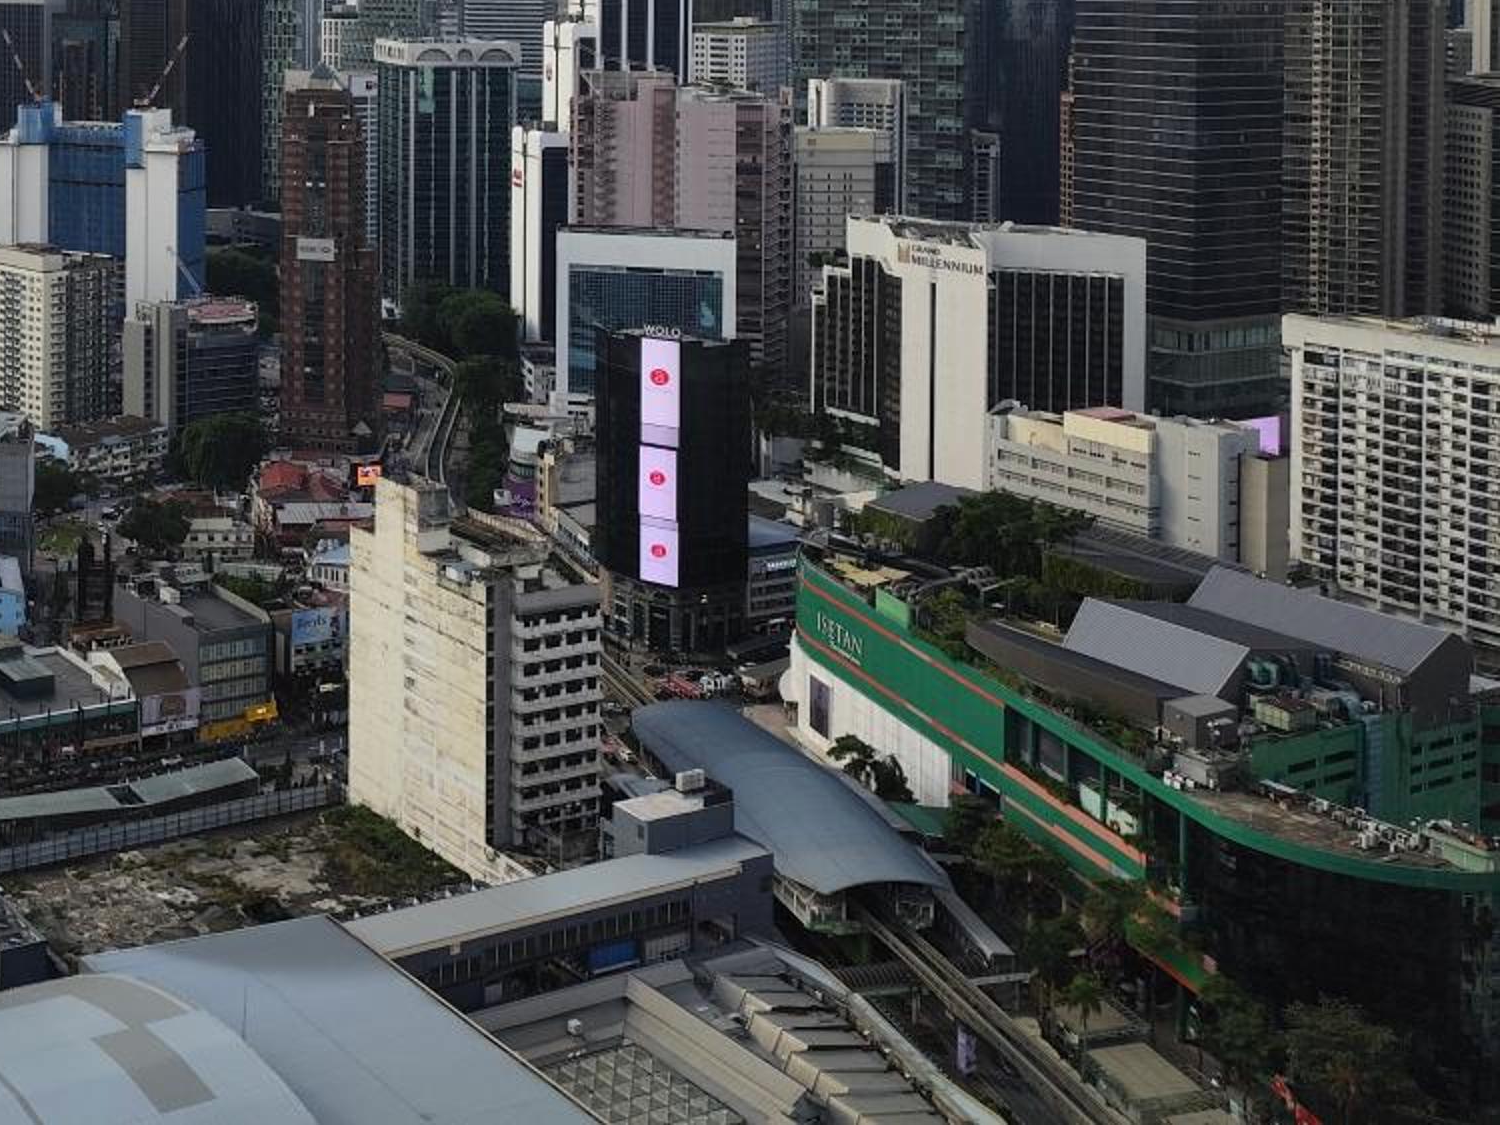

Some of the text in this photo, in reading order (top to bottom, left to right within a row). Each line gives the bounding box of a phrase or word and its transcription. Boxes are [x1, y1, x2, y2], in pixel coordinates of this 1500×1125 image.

[911, 254, 984, 275] MILLENNIUM
[643, 324, 681, 338] WOLO
[817, 611, 863, 655] ISETAN
